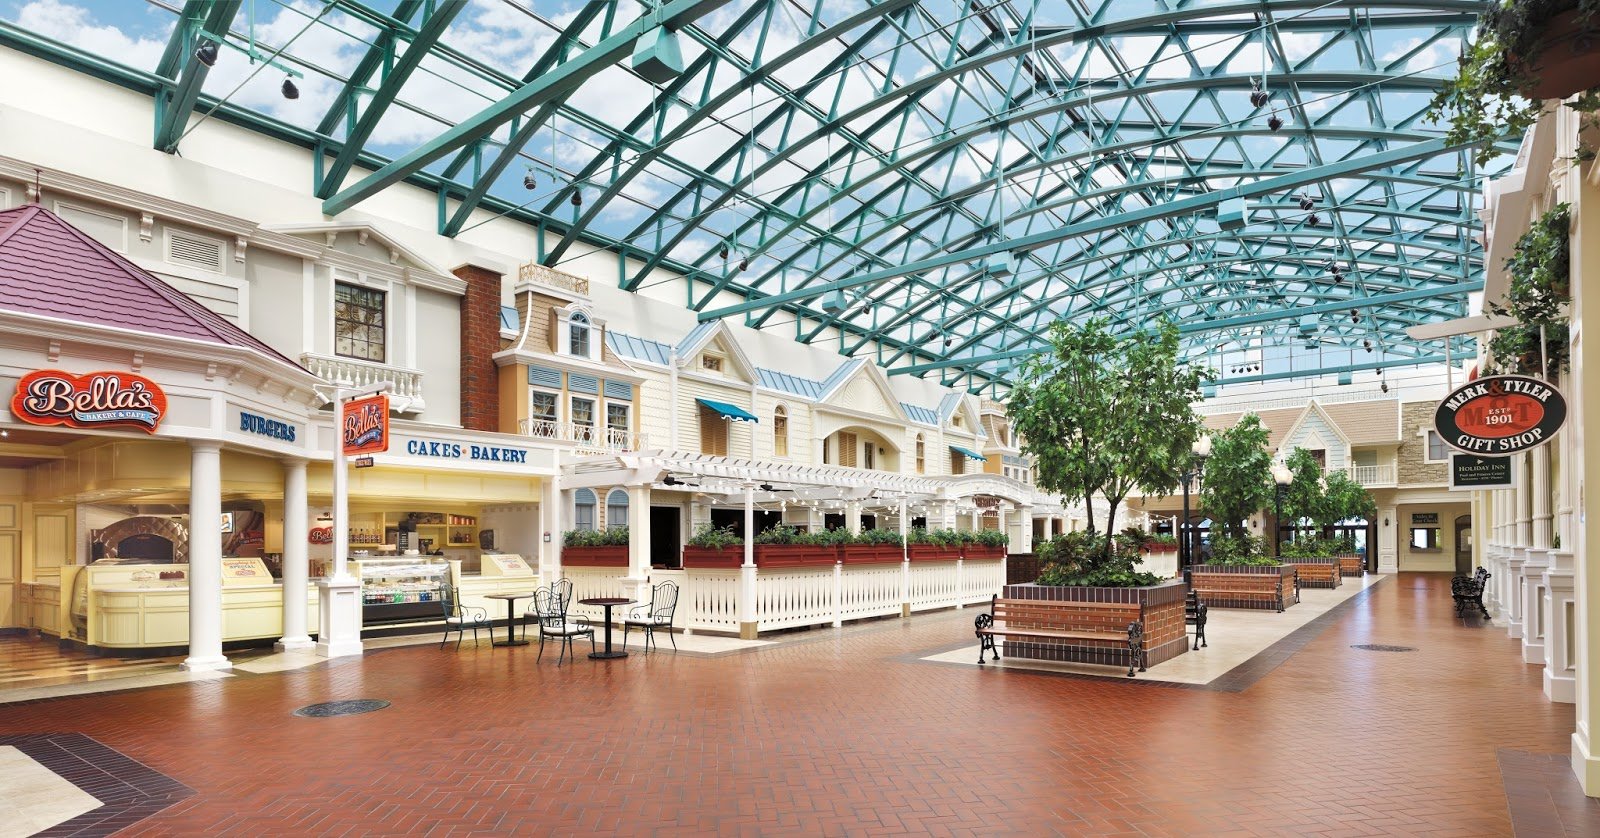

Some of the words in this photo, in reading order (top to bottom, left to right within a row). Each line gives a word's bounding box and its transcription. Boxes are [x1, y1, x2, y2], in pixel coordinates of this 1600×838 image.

[26, 375, 151, 416] Bella's
[1445, 384, 1489, 411] MERK
[1489, 379, 1507, 396] &
[1503, 380, 1553, 403] TYLER
[86, 412, 117, 420] BAKERY
[119, 410, 124, 418] &
[240, 411, 295, 442] BURGERS
[344, 403, 380, 443] Bella's
[1485, 414, 1513, 425] 1901
[407, 440, 460, 459] CAKES
[470, 445, 527, 463] BAKERY
[1457, 434, 1495, 451] GIFT
[1499, 427, 1543, 451] SHOP
